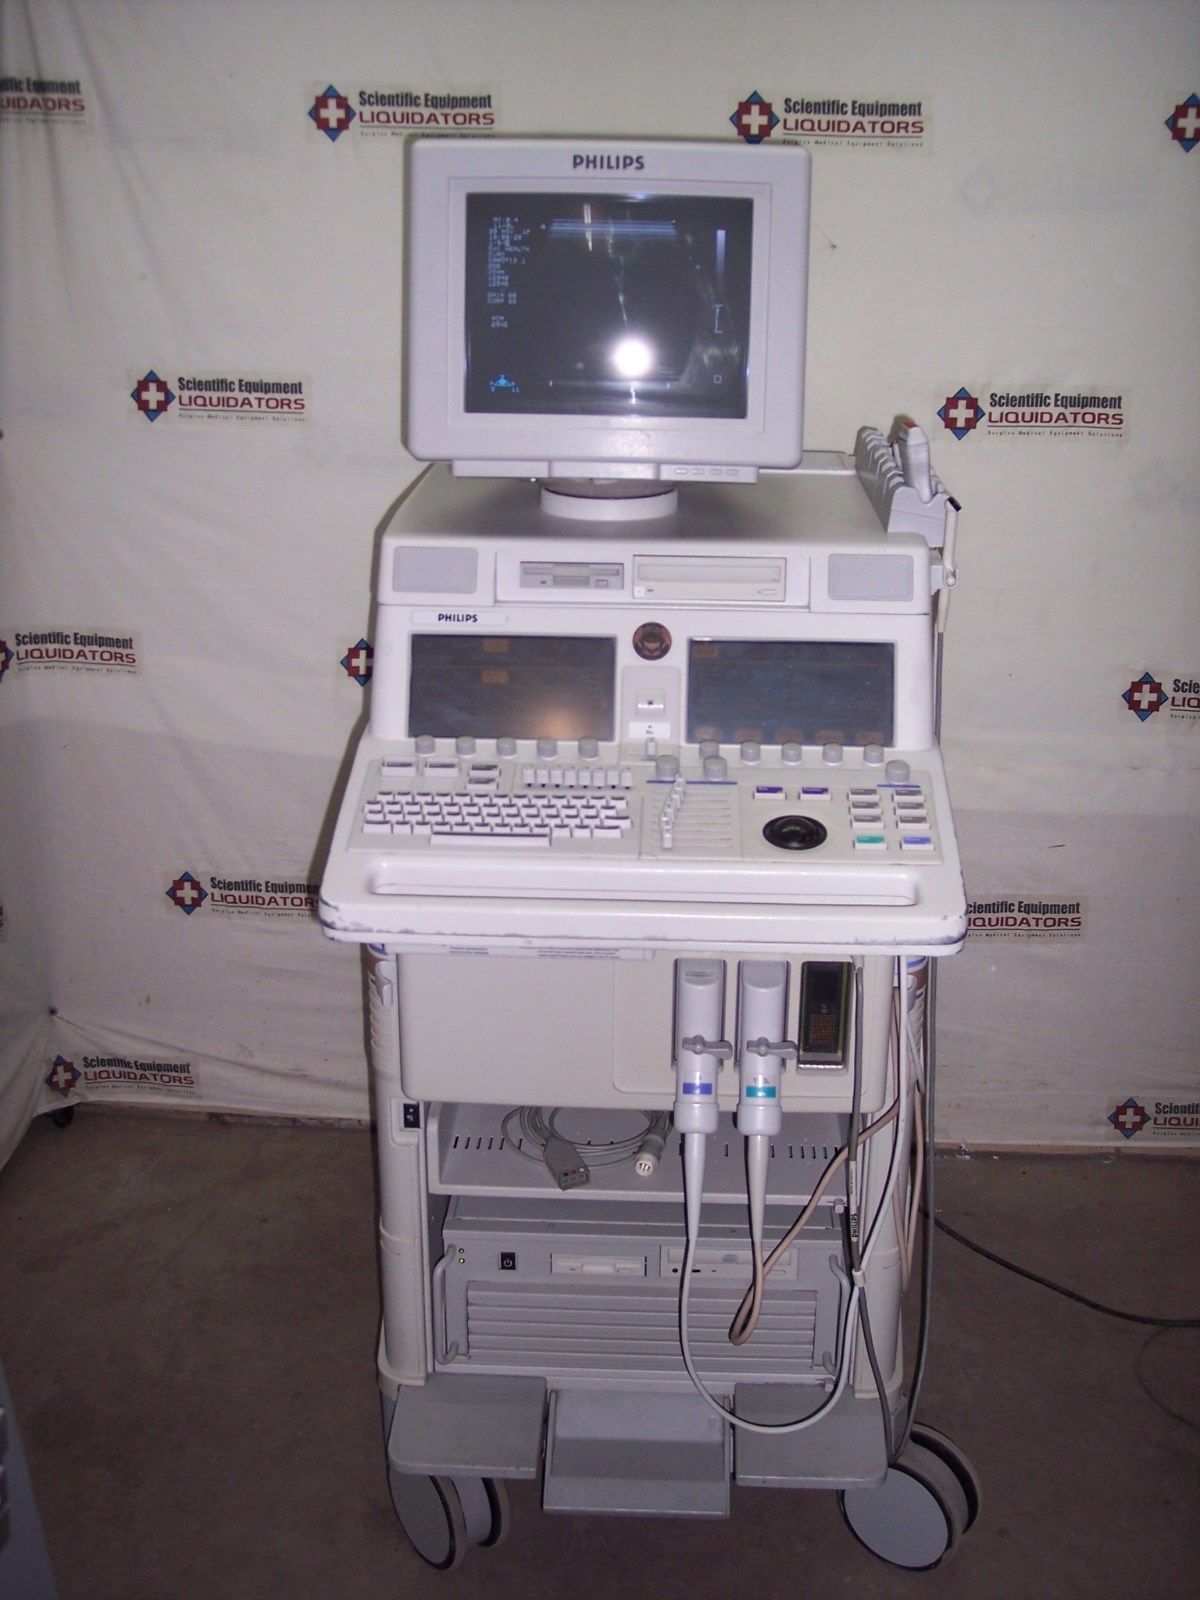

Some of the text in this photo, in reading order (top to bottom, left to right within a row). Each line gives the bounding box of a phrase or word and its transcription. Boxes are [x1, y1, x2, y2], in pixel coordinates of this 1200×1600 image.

[359, 91, 492, 109] Scientific Equipment
[784, 98, 922, 117] Scientific Equipment
[359, 111, 495, 125] LIQUIDATORS
[783, 118, 924, 133] LIQUIDATORS
[573, 154, 645, 170] PHILIPS
[178, 377, 303, 394] Scientific Equipment
[178, 395, 305, 410] LIQUIDATORS
[989, 393, 1122, 409] Scientific Equipment
[988, 411, 1123, 425] LIQUIDATORS
[438, 613, 478, 623] PHILIPS
[15, 631, 134, 650] Scientific Equipment
[16, 647, 136, 663] LIQUIDATORS
[210, 877, 262, 893] Scientific
[211, 892, 319, 907] LIQUIDATOR
[967, 901, 1080, 915] cientific Equipment
[968, 916, 1081, 927] IQUIDATORS
[83, 1056, 134, 1069] Scientific
[84, 1069, 194, 1084] LIQUIDATORS
[1155, 1102, 1200, 1114] Scientif
